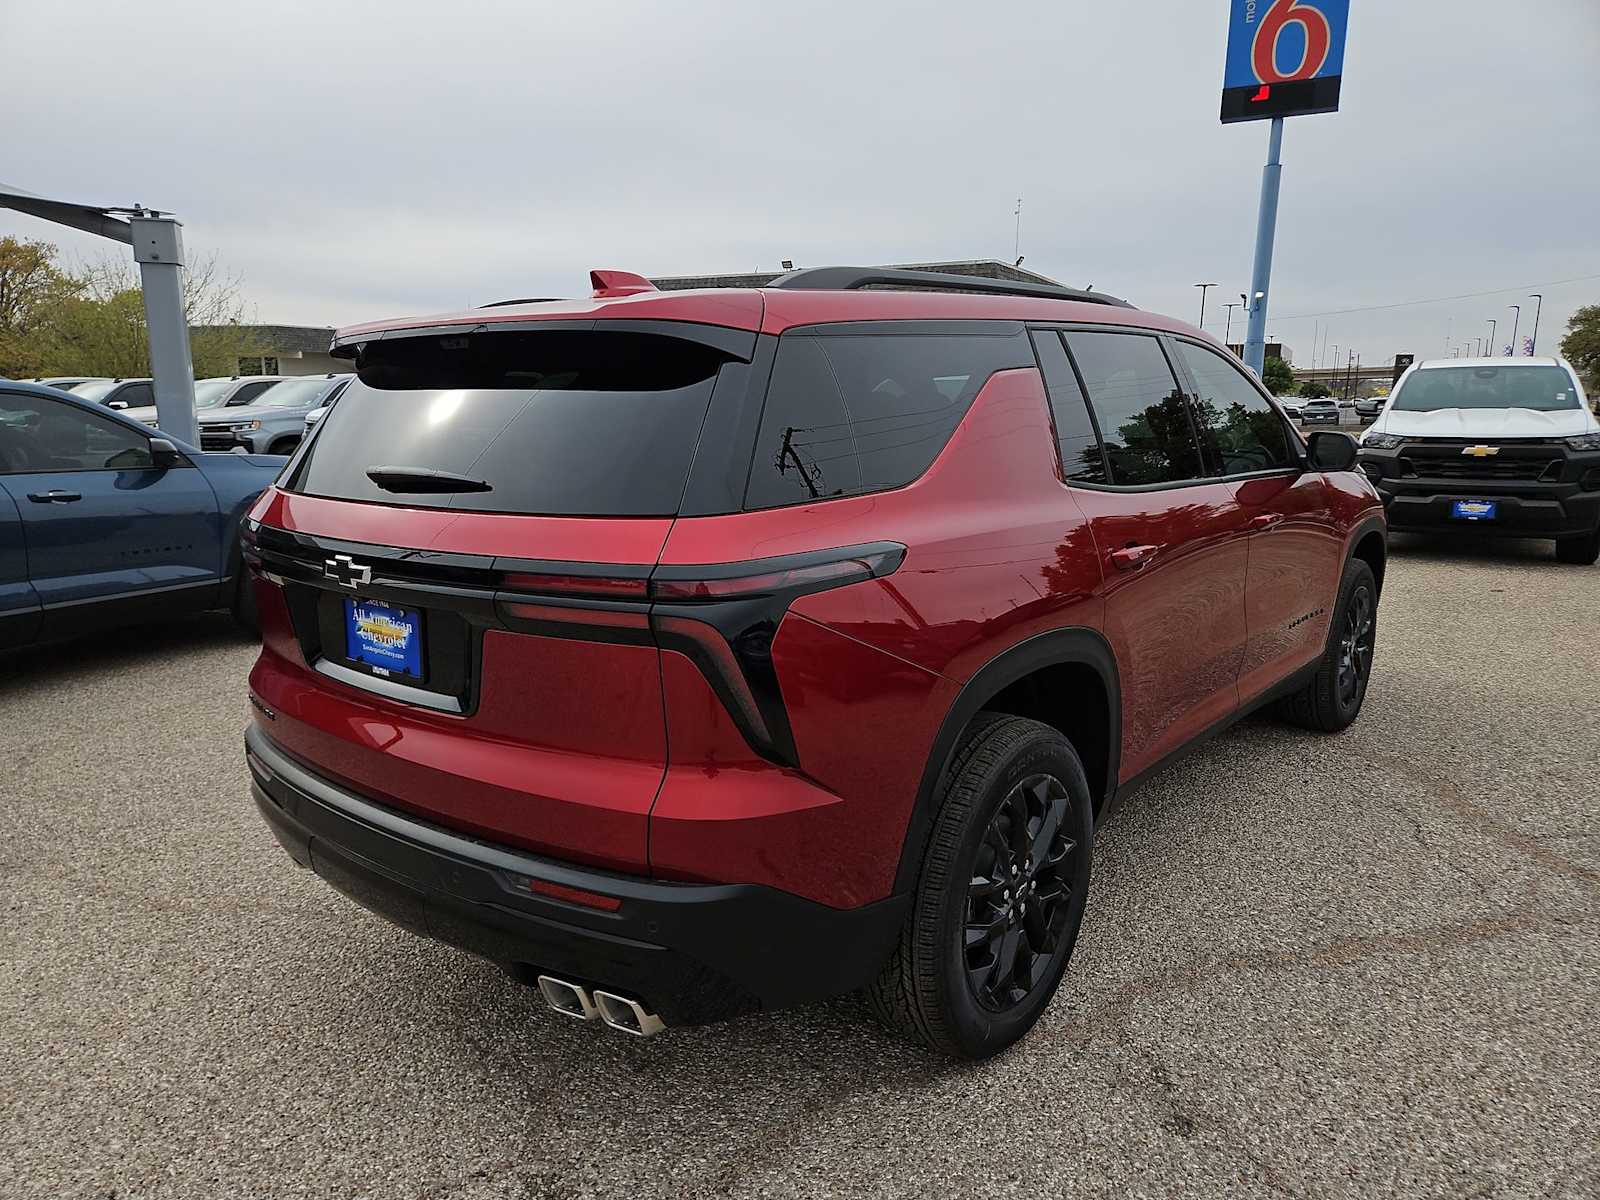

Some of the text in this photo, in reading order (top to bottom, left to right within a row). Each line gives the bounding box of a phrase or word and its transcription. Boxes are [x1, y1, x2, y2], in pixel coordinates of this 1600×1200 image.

[1251, 0, 1330, 84] 6
[353, 608, 413, 633] All American
[360, 627, 406, 649] Chevrolet
